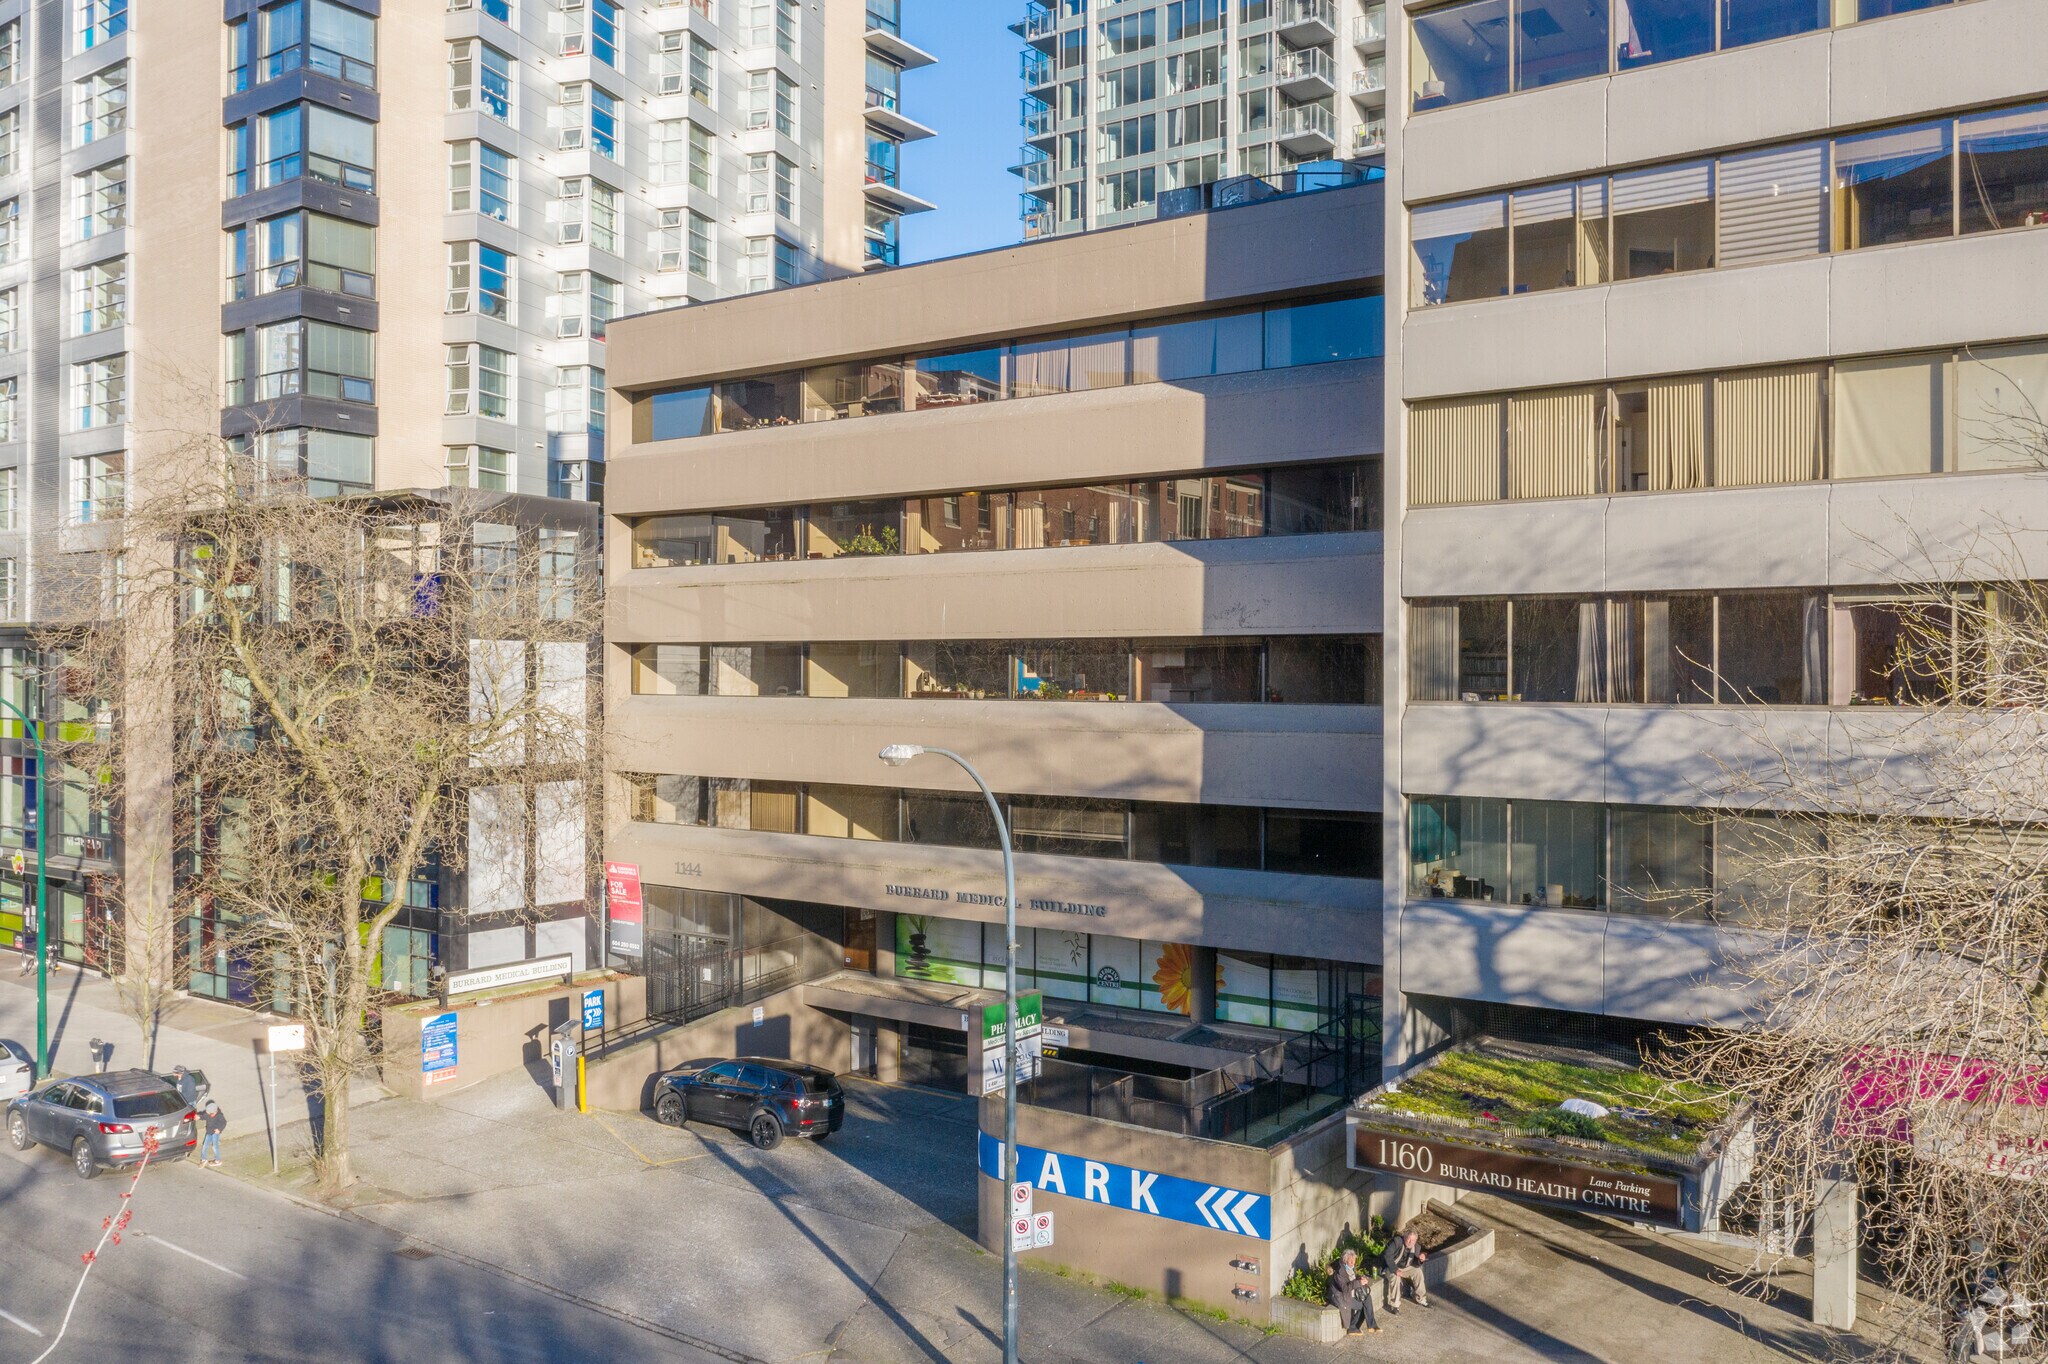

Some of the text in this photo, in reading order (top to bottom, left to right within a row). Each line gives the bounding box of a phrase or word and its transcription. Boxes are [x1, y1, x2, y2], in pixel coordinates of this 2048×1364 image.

[674, 861, 702, 877] 1144
[610, 881, 624, 889] FOR
[611, 888, 627, 896] SALE
[886, 885, 949, 901] BURRARD
[1030, 899, 1107, 917] BUILDING
[452, 962, 568, 989] BURRARD MEDICAL BUILDING
[584, 995, 602, 1009] PARK
[991, 1013, 1037, 1036] PHAMACY
[1378, 1138, 1651, 1214] 1160 BURRARD HEALTH CENTRE
[1589, 1175, 1651, 1197] Lane Parking
